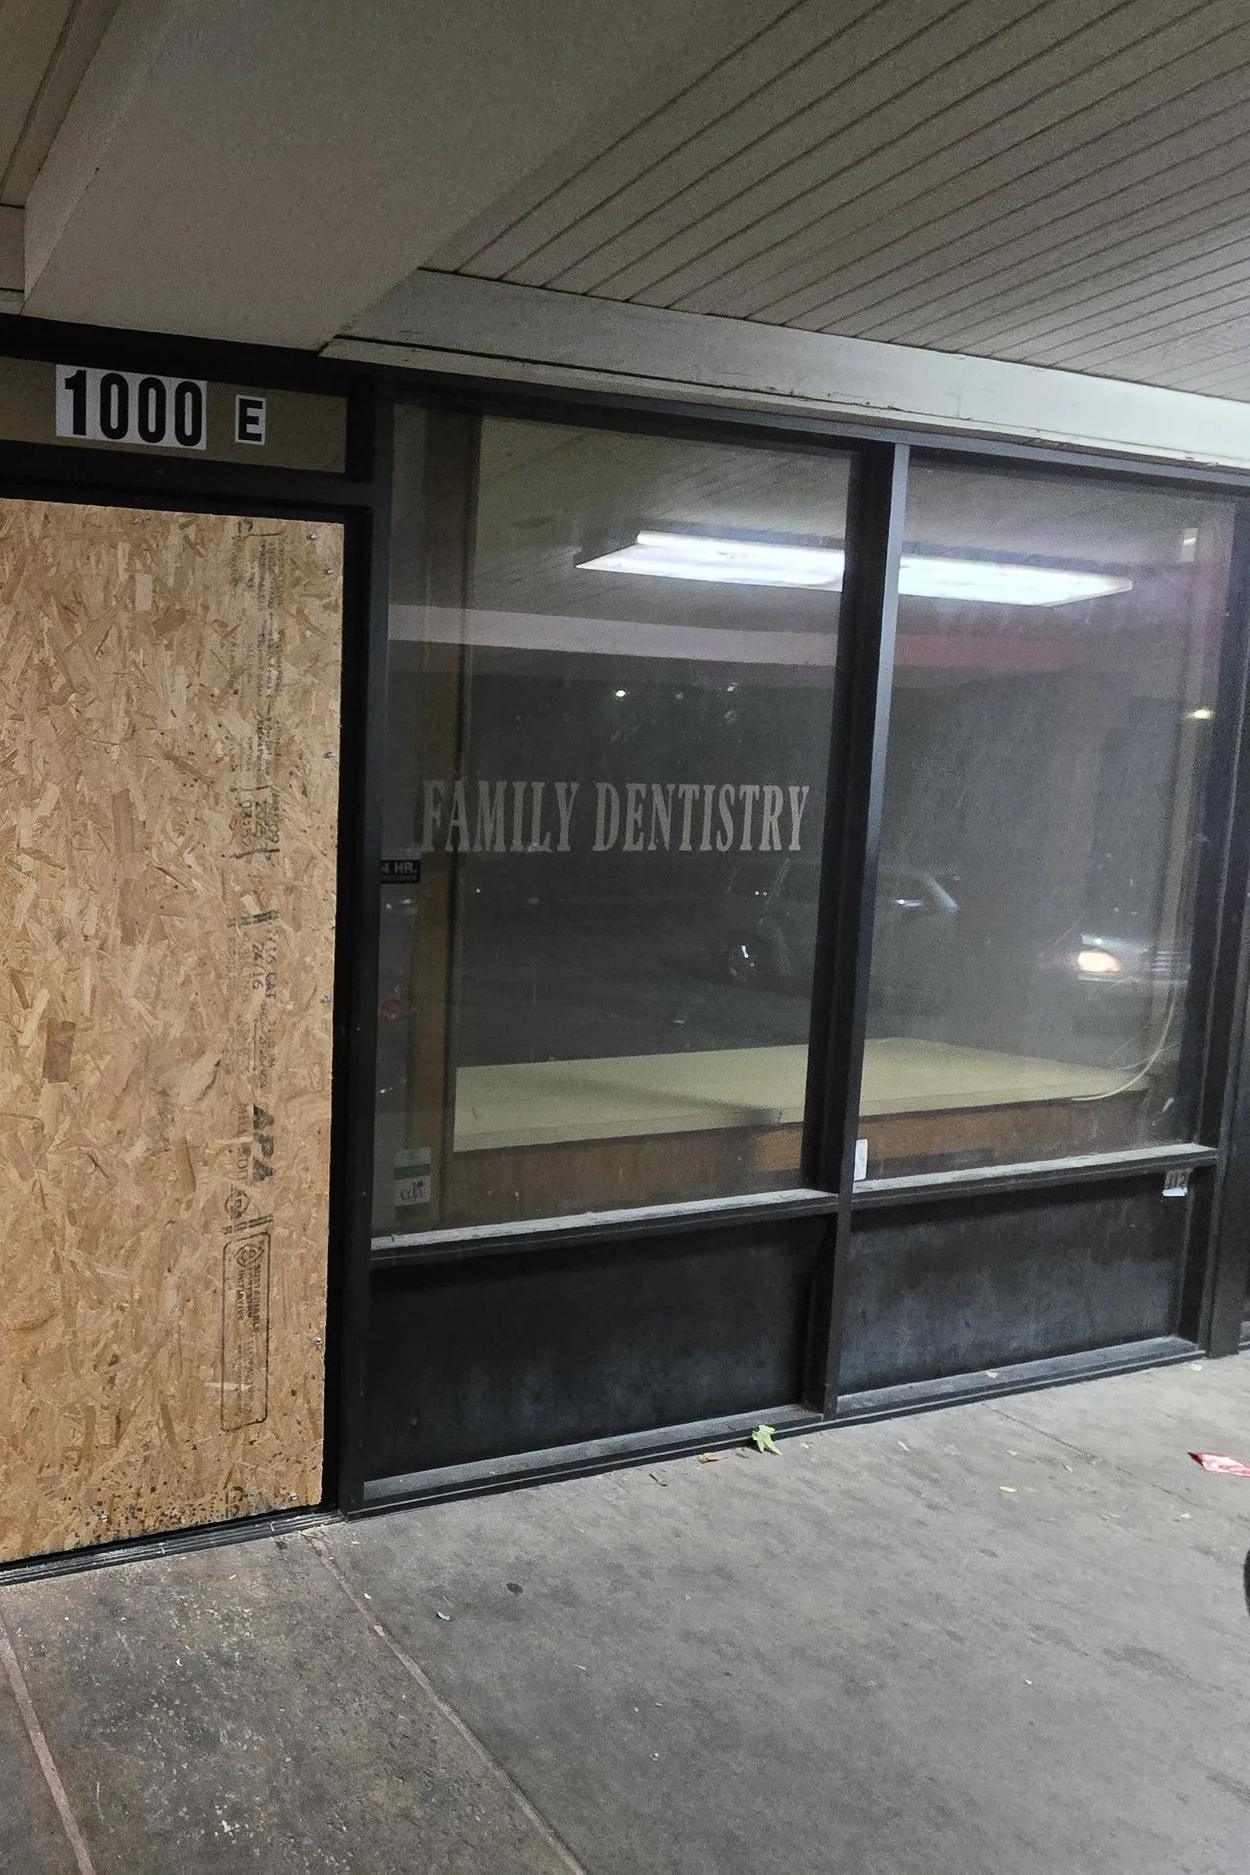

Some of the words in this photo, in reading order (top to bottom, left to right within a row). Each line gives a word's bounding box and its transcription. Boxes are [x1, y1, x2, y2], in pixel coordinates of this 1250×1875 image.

[64, 369, 203, 447] 1000
[238, 397, 263, 442] E
[420, 779, 580, 853] FAMILY
[592, 781, 810, 853] DENTISTRY
